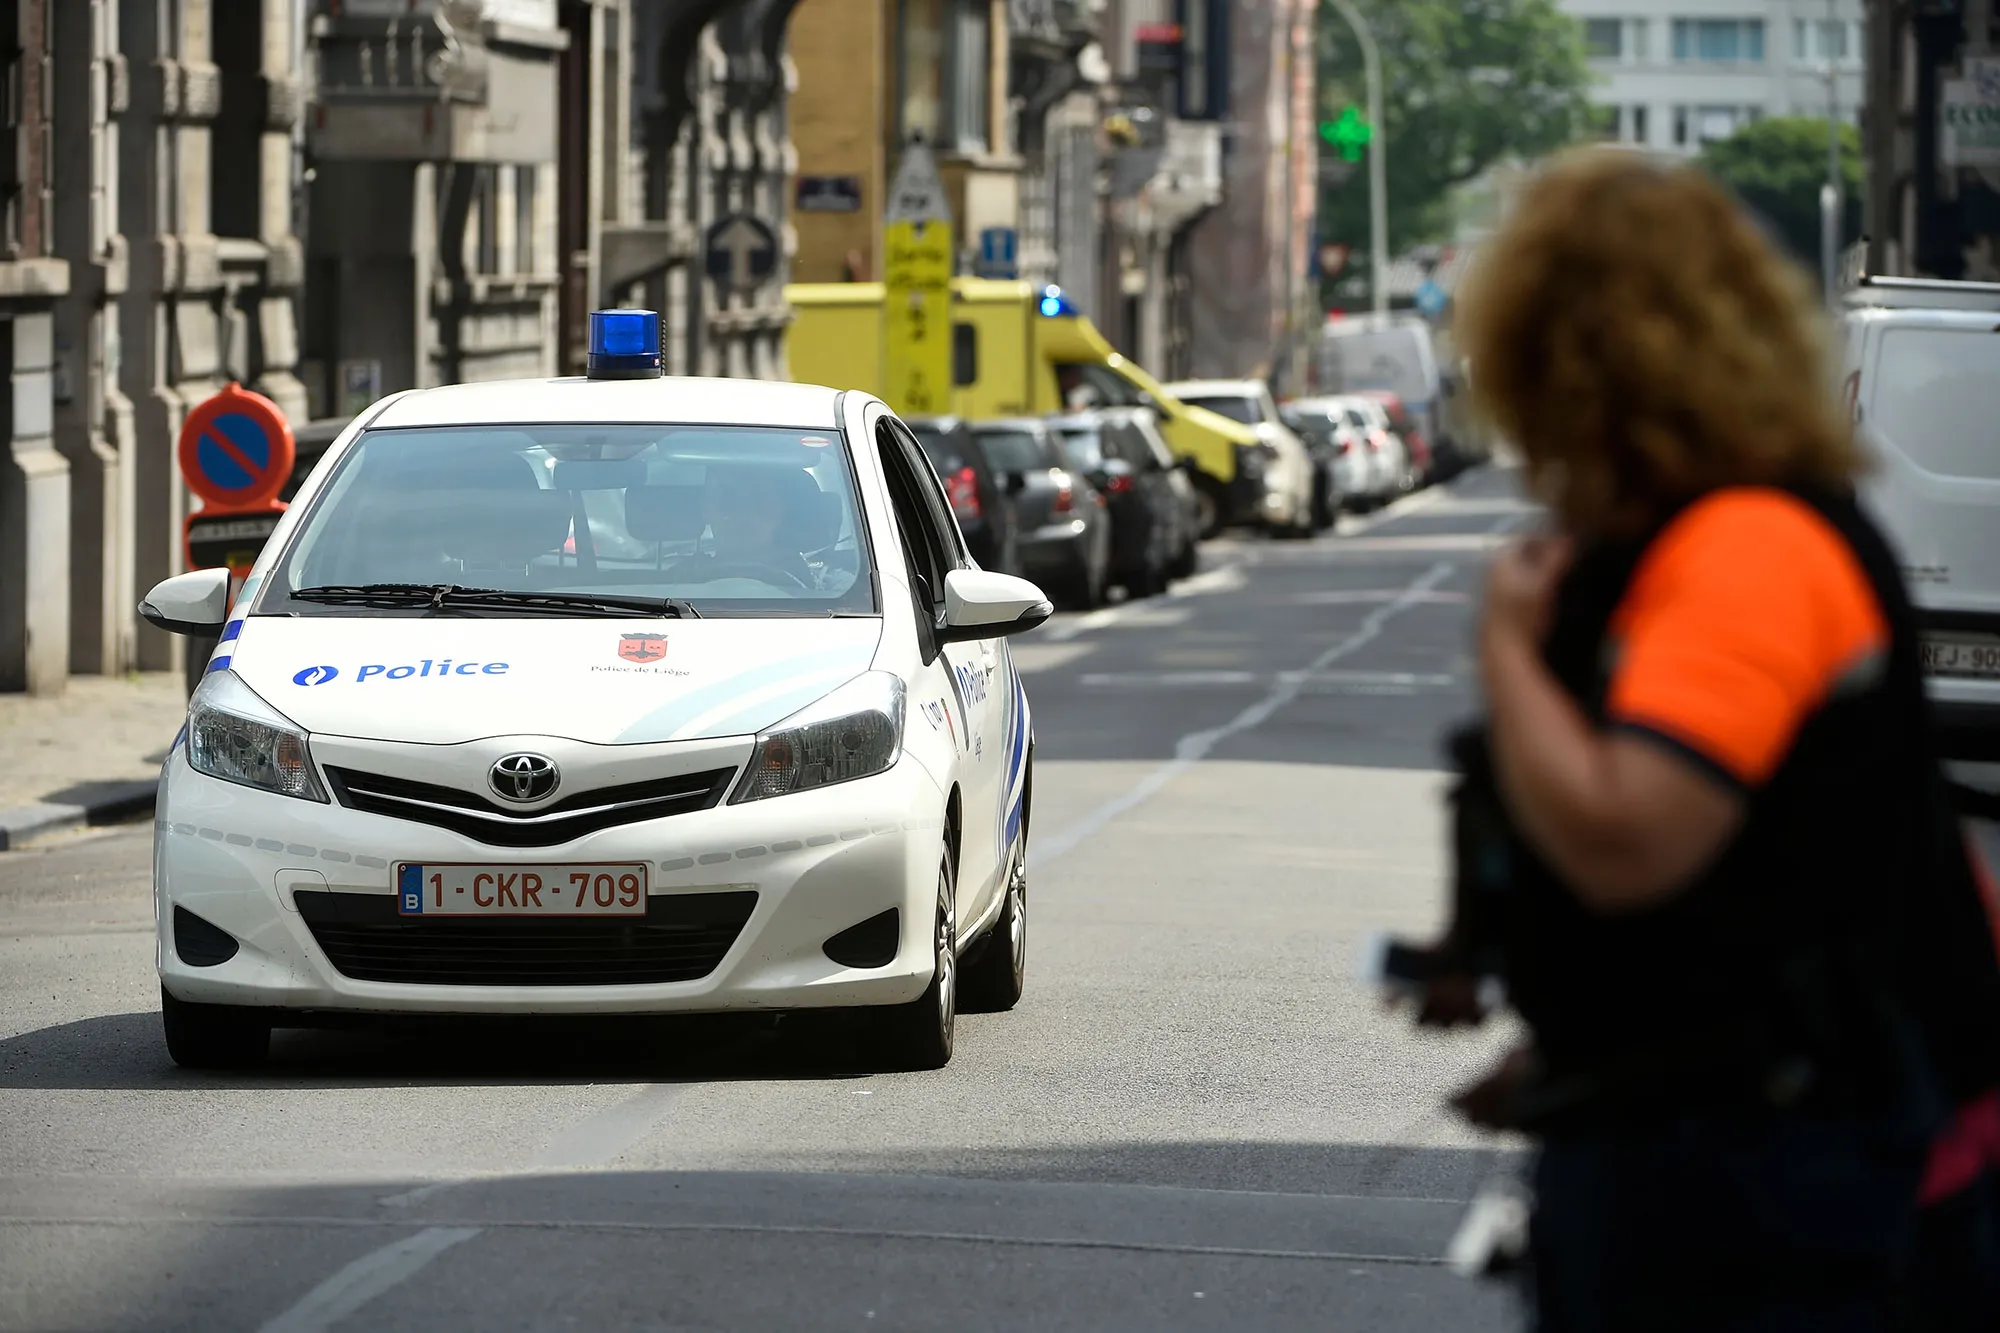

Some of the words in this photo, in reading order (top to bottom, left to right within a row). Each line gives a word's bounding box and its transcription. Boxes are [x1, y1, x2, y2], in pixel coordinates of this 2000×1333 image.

[356, 659, 509, 682] Police
[590, 665, 630, 674] Police
[634, 666, 650, 674] de
[654, 667, 691, 677] Liège
[430, 873, 640, 908] 1-CKR-709
[405, 893, 419, 909] B
